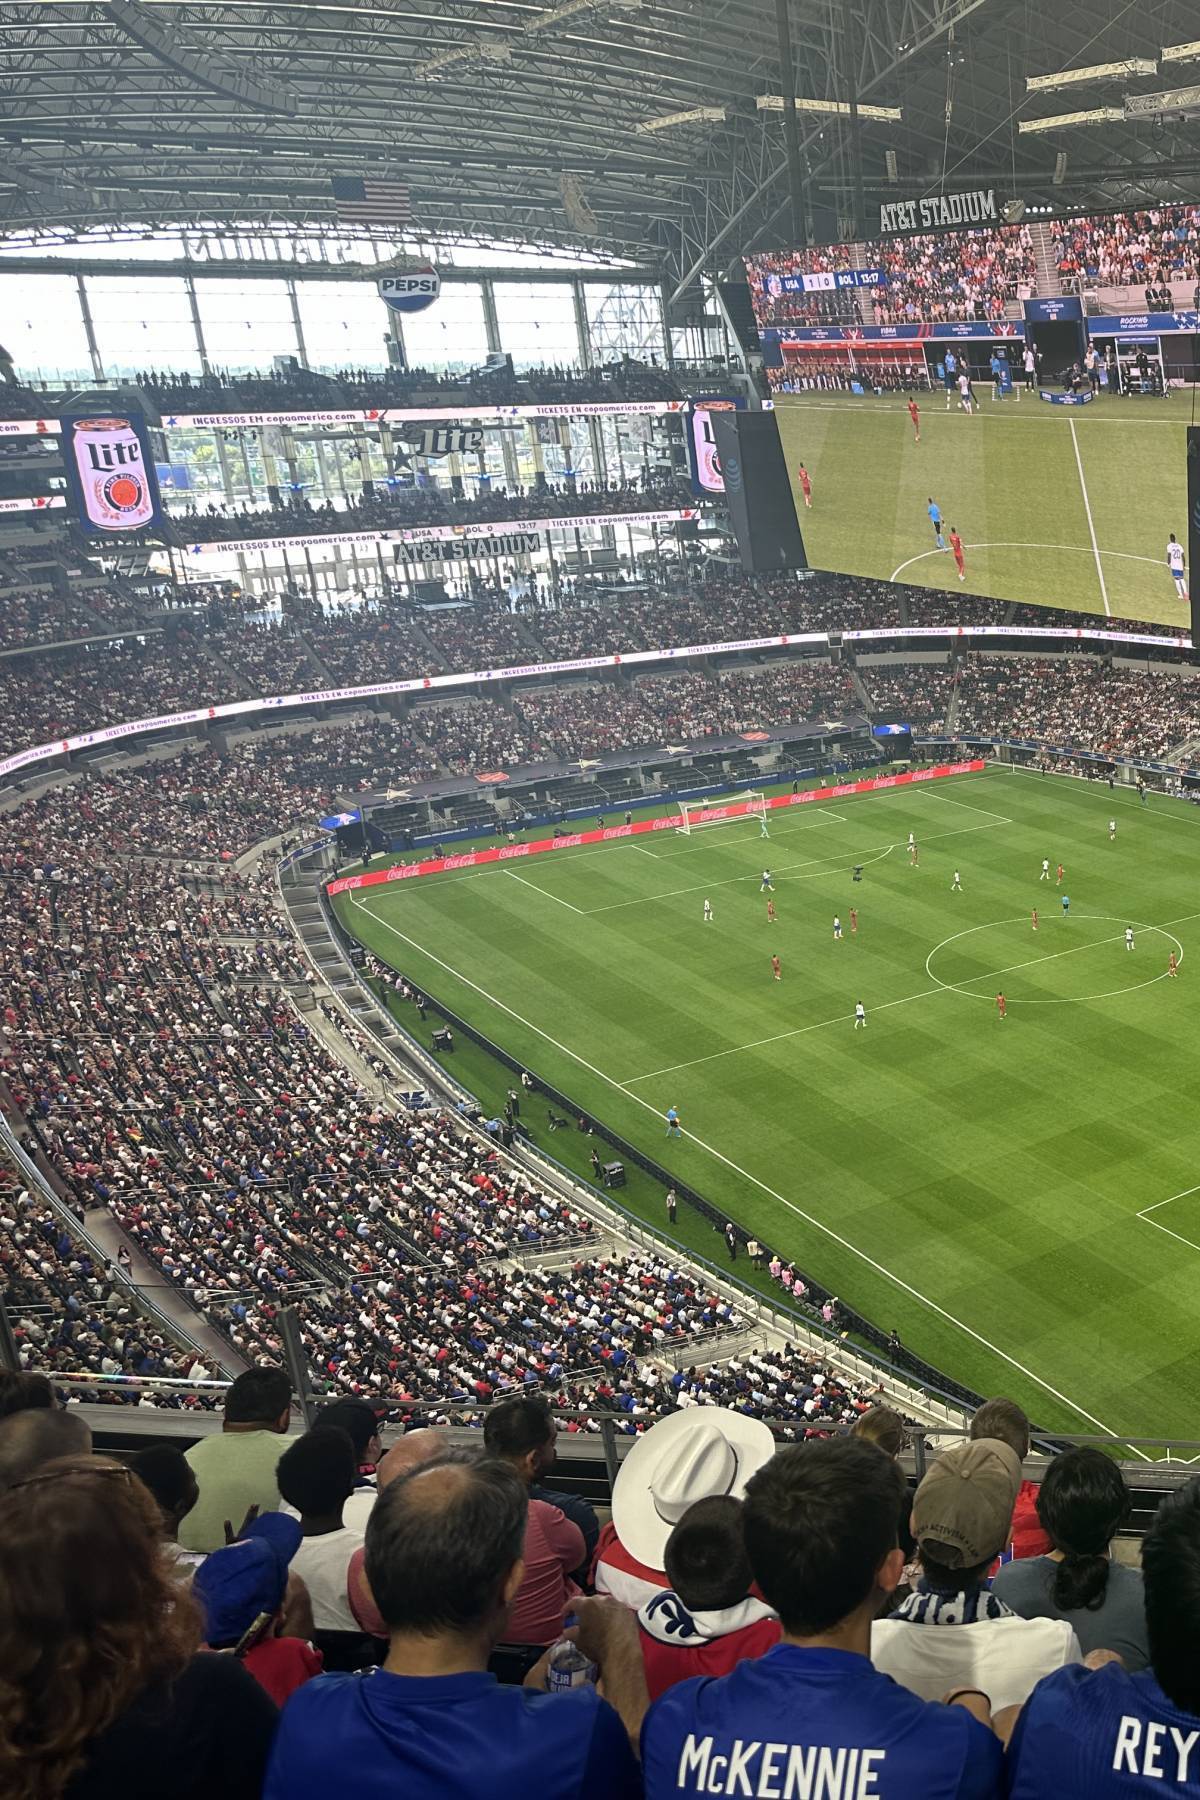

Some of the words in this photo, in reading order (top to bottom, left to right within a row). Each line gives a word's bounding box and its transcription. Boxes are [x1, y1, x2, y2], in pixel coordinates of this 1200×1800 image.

[880, 202, 917, 232] AT&T
[920, 190, 997, 226] STADIUM
[383, 279, 437, 292] PEPSI
[784, 279, 800, 291] USA
[838, 275, 854, 286] BOL
[860, 273, 880, 285] 13:17
[536, 406, 569, 415] TICKETS
[192, 415, 247, 425] INGRESSOS
[249, 415, 264, 423] EM
[419, 429, 484, 458] Lite
[85, 441, 140, 473] Lite
[551, 518, 583, 529] TICKETS
[585, 518, 596, 526] EN
[217, 542, 270, 553] INGRESSOS
[271, 540, 286, 548] EM
[397, 541, 446, 564] AT&T
[451, 534, 540, 560] STADIUM
[300, 693, 330, 702] TICKETS
[677, 1734, 885, 1800] McKENNIE
